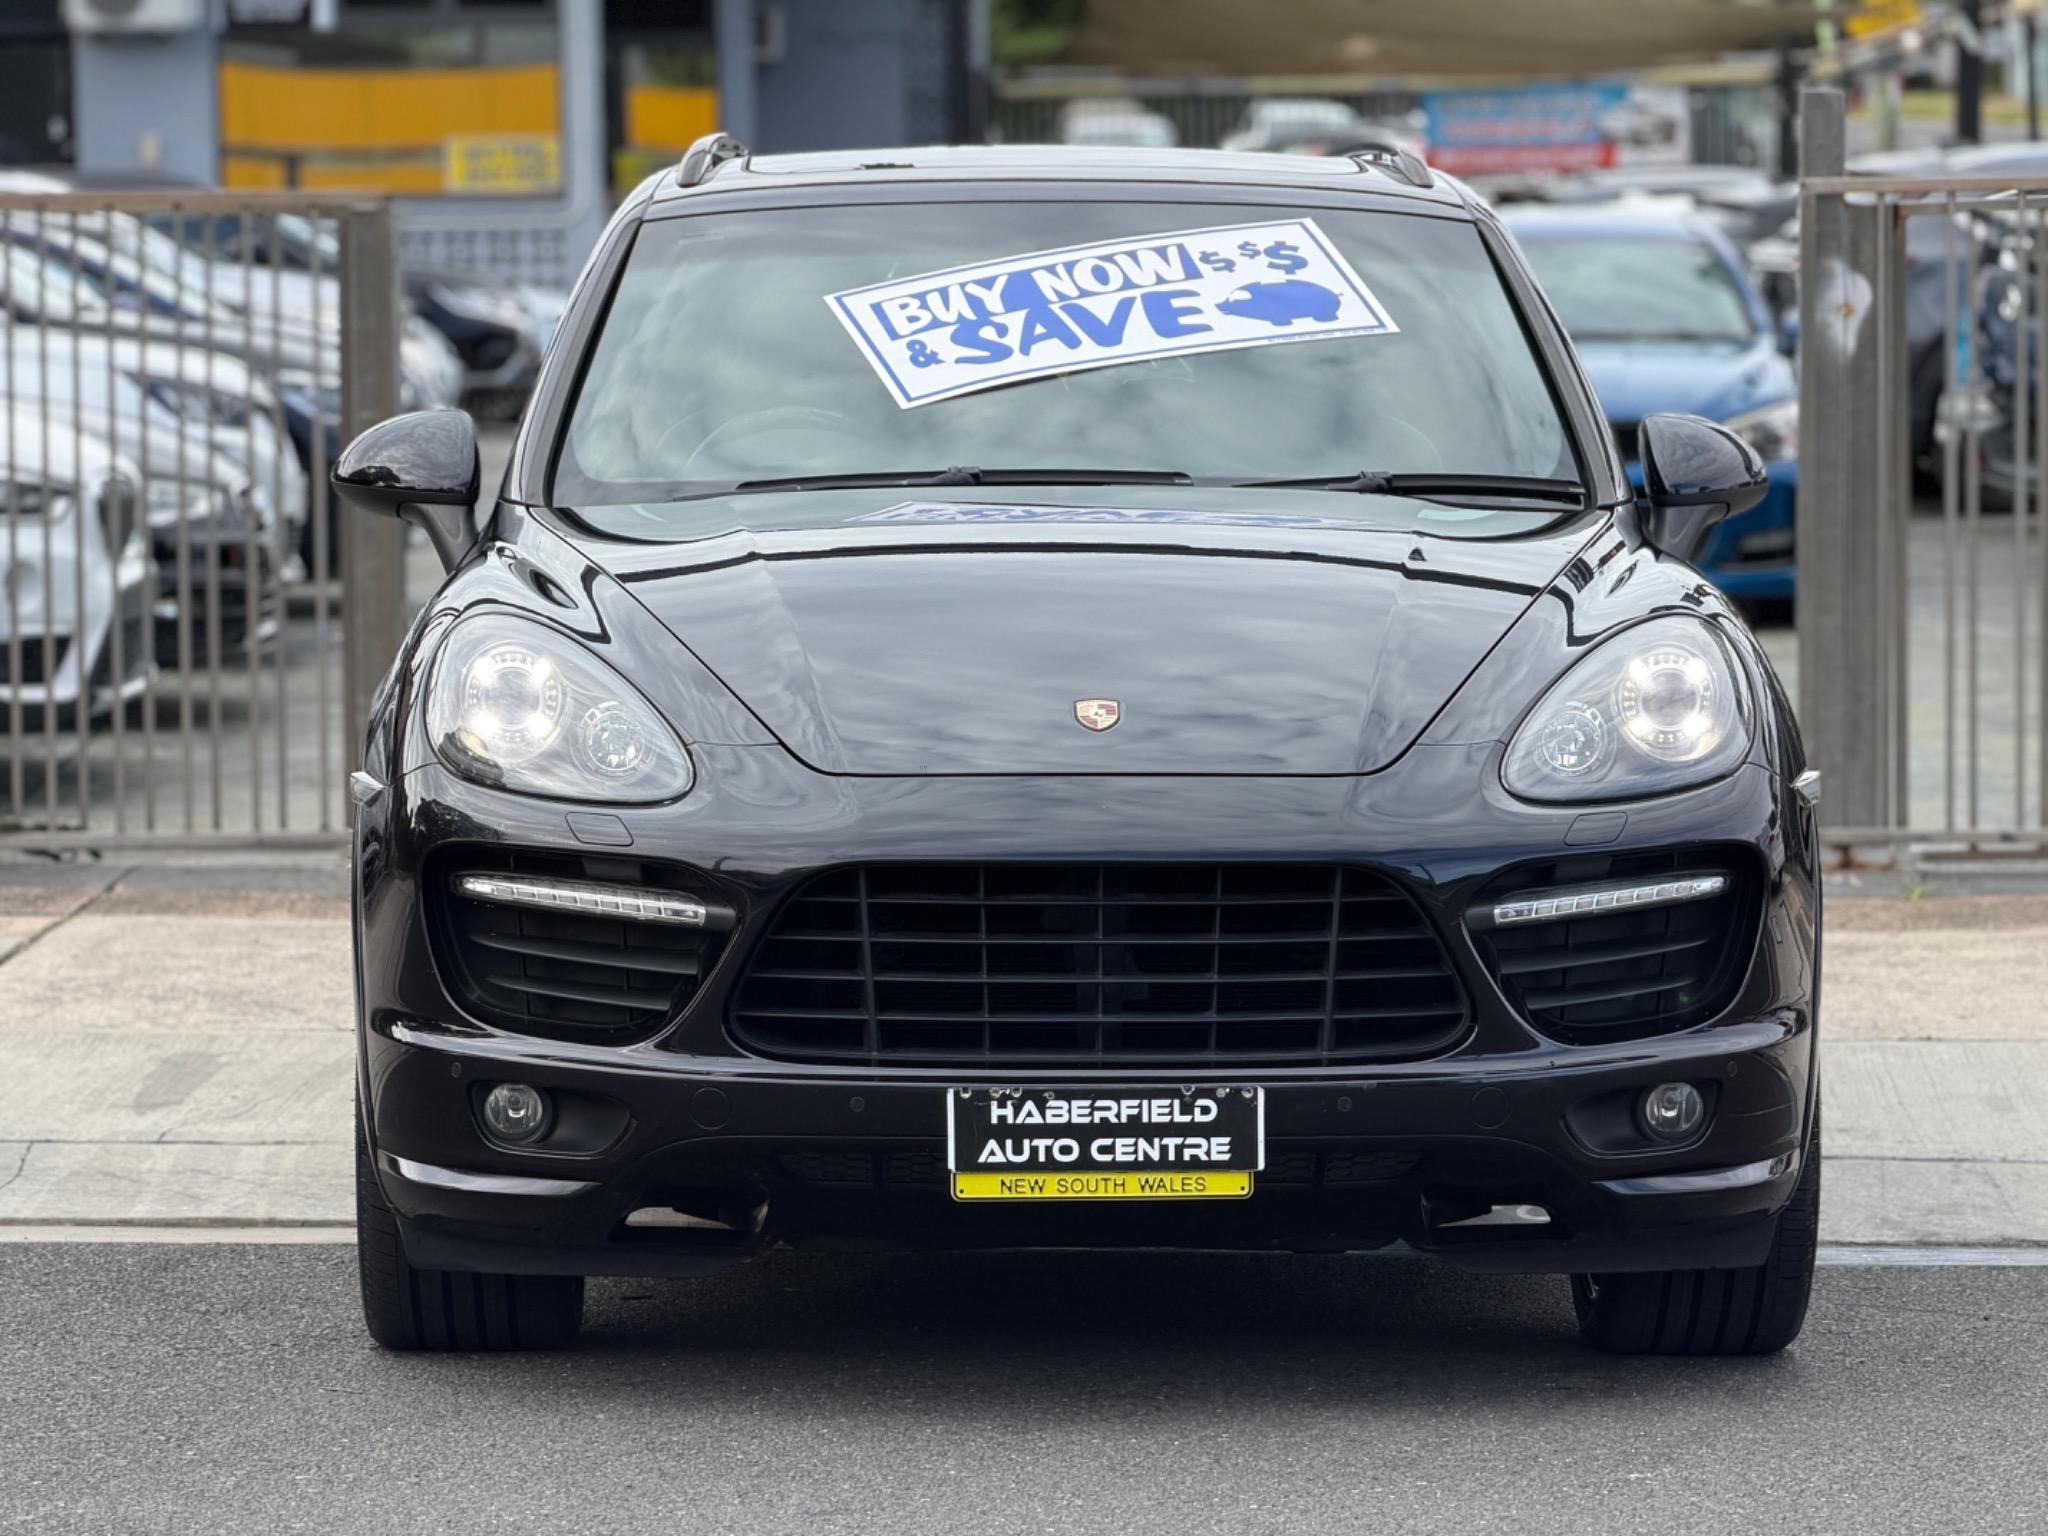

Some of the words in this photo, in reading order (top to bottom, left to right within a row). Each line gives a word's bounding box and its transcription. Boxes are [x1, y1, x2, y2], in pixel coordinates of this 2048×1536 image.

[881, 275, 1009, 337] BUY
[1031, 244, 1186, 302] NOW
[906, 339, 947, 368] &
[950, 288, 1214, 365] SAVE
[990, 1098, 1219, 1125] HABERFIELD
[977, 1138, 1080, 1164] AUTO
[1090, 1136, 1232, 1162] CENTRE
[1000, 1177, 1046, 1195] NEW
[1056, 1177, 1126, 1194] SOUTH
[1138, 1176, 1207, 1193] WALES
